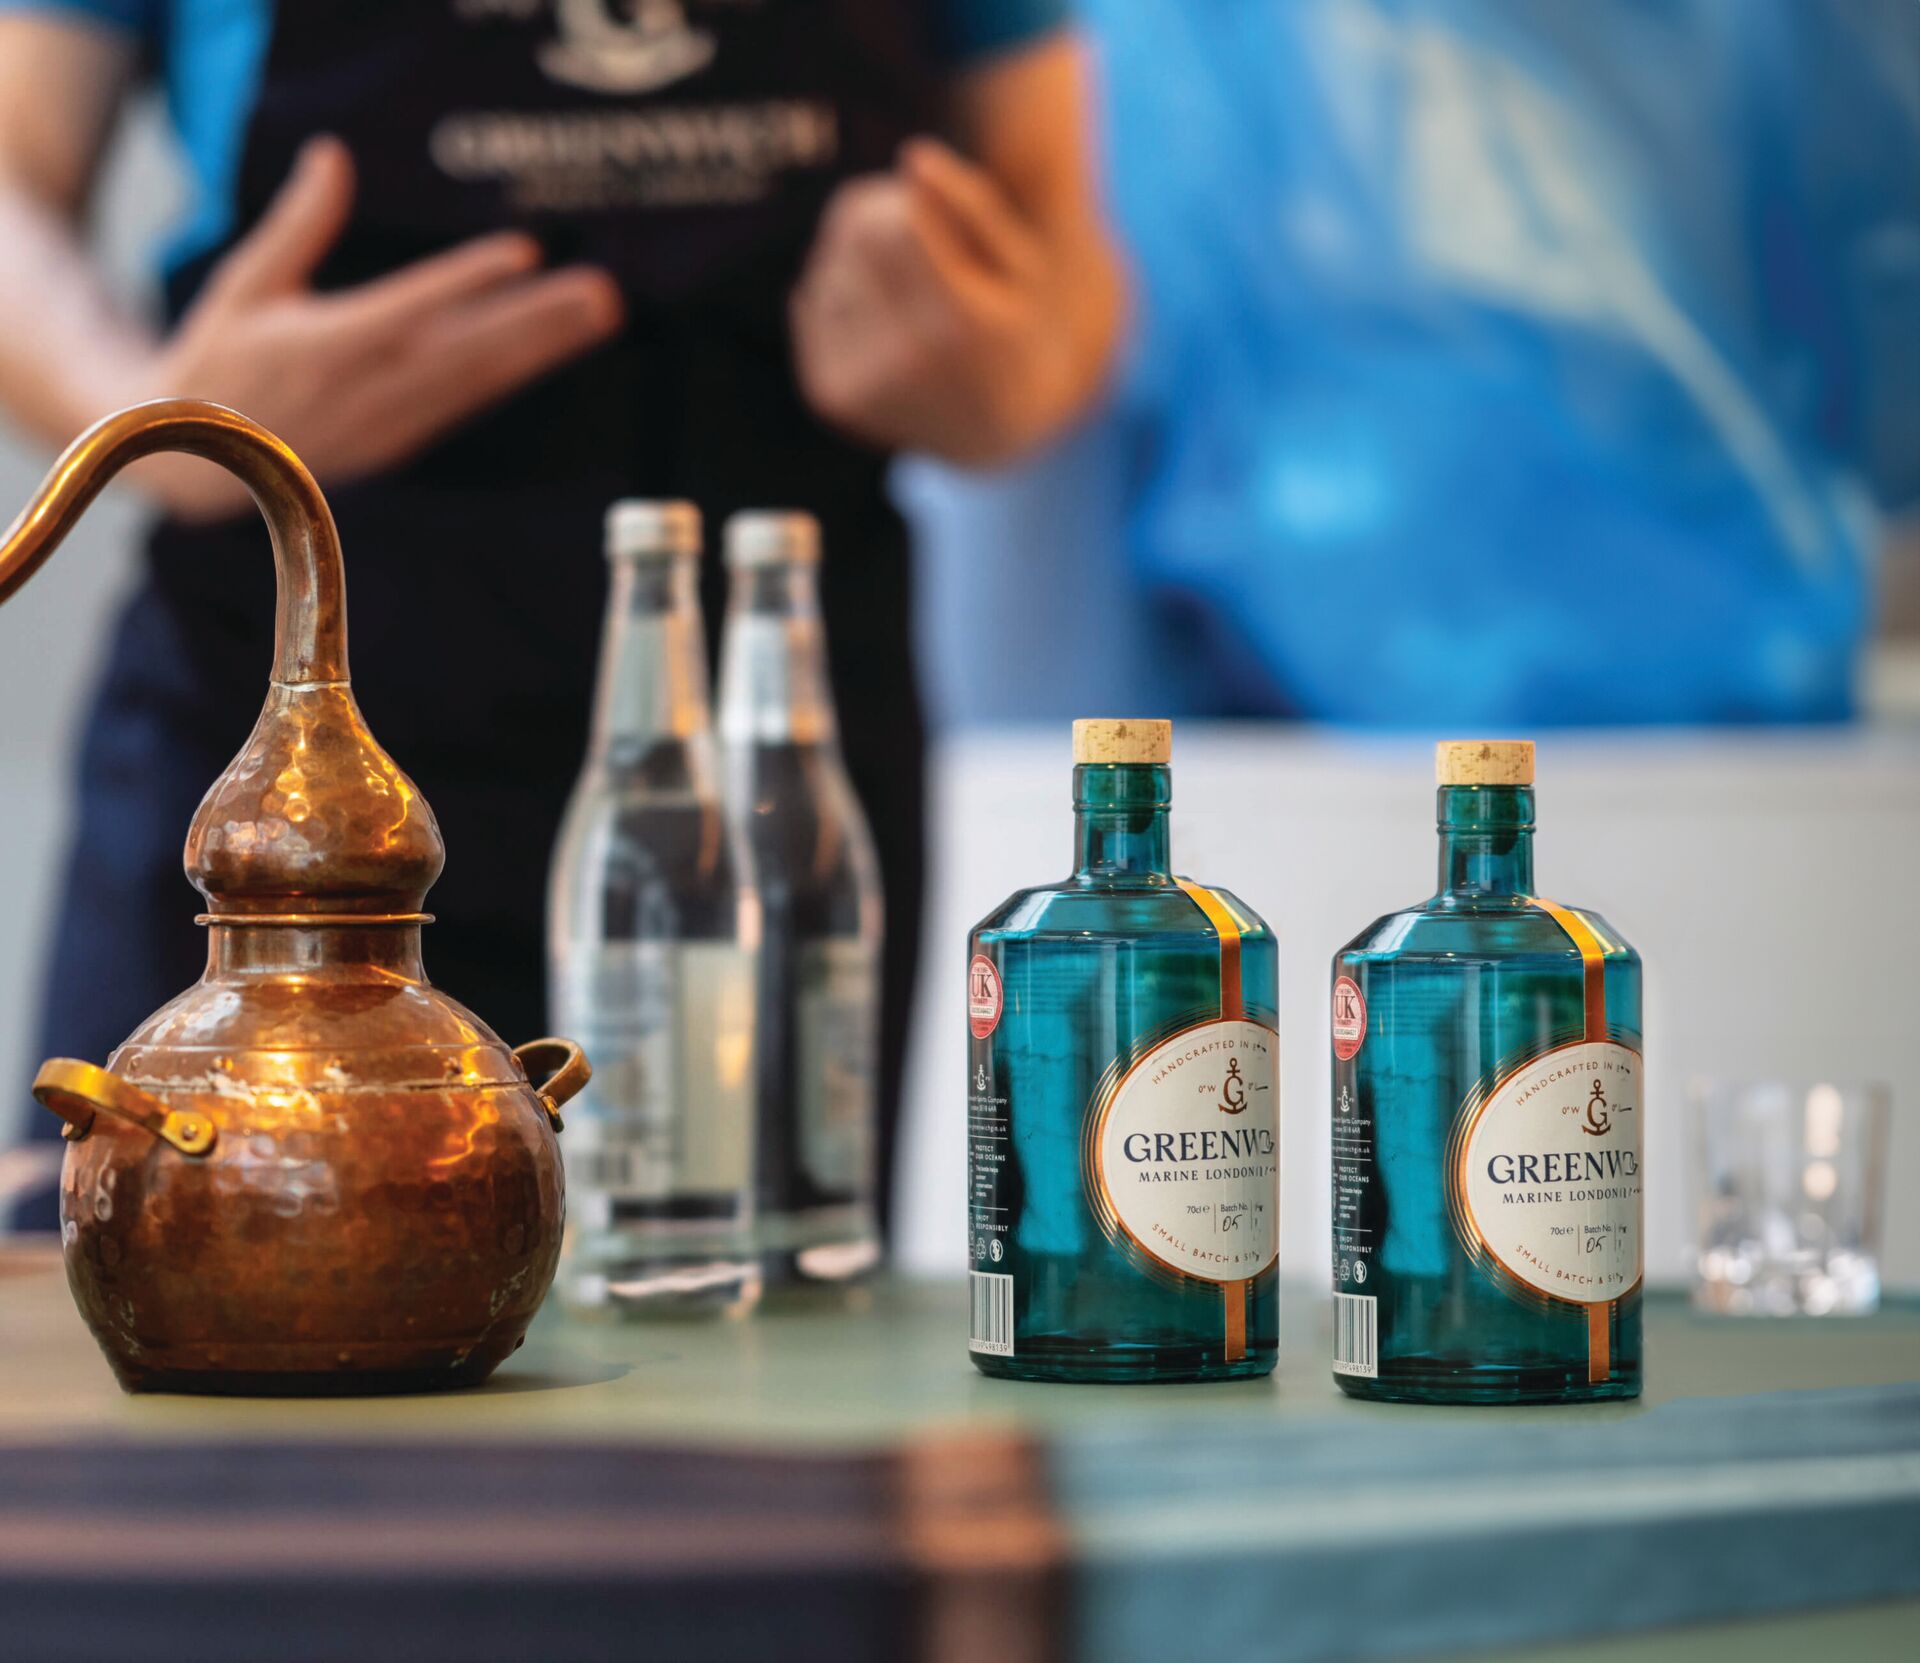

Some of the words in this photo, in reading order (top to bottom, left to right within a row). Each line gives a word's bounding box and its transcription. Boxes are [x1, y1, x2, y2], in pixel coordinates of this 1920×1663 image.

[971, 974, 992, 997] UK
[1335, 996, 1356, 1019] UK
[1151, 1039, 1235, 1085] HANDCRAFTED
[1240, 1039, 1249, 1048] IN
[1515, 1061, 1599, 1107] HANDCRAFTED
[1604, 1061, 1613, 1070] IN
[1123, 1129, 1275, 1162] GREENW
[1139, 1170, 1199, 1183] MARINE
[1487, 1151, 1639, 1184] GREENW
[1221, 1203, 1237, 1212] Batch
[1503, 1192, 1563, 1205] MARINE
[1152, 1223, 1186, 1252] SMALL
[1193, 1248, 1229, 1263] BATCH
[1585, 1225, 1601, 1234] Batch
[1516, 1245, 1550, 1274] SMALL
[1557, 1270, 1593, 1285] BATCH
